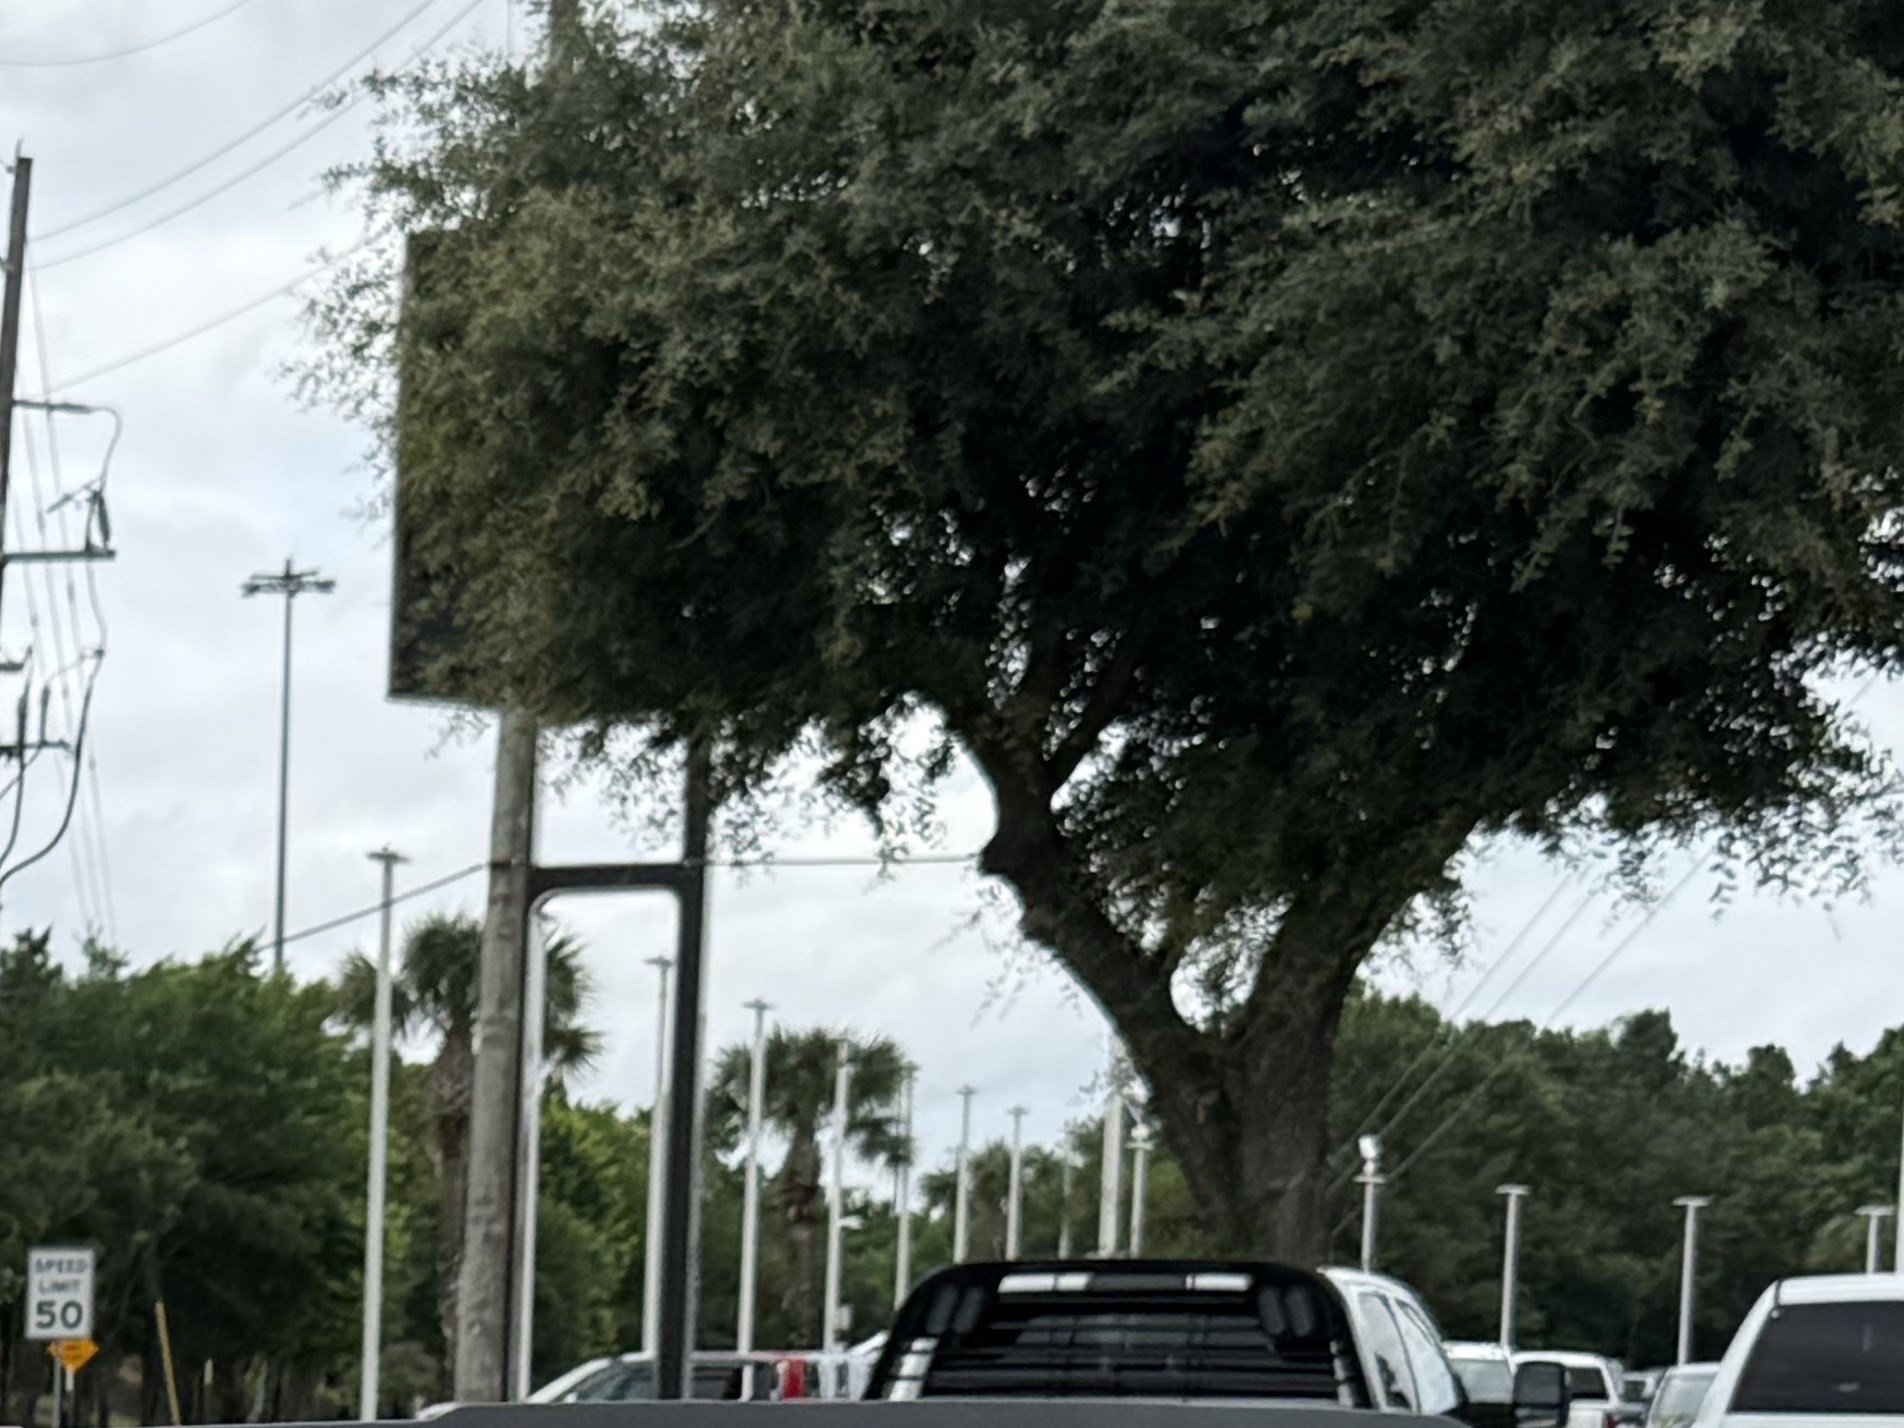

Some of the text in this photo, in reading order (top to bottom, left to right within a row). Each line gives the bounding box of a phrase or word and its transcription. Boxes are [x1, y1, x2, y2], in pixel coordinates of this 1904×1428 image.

[34, 1257, 90, 1275] SPEED
[38, 1279, 82, 1294] LIMIT
[35, 1300, 84, 1330] 50
